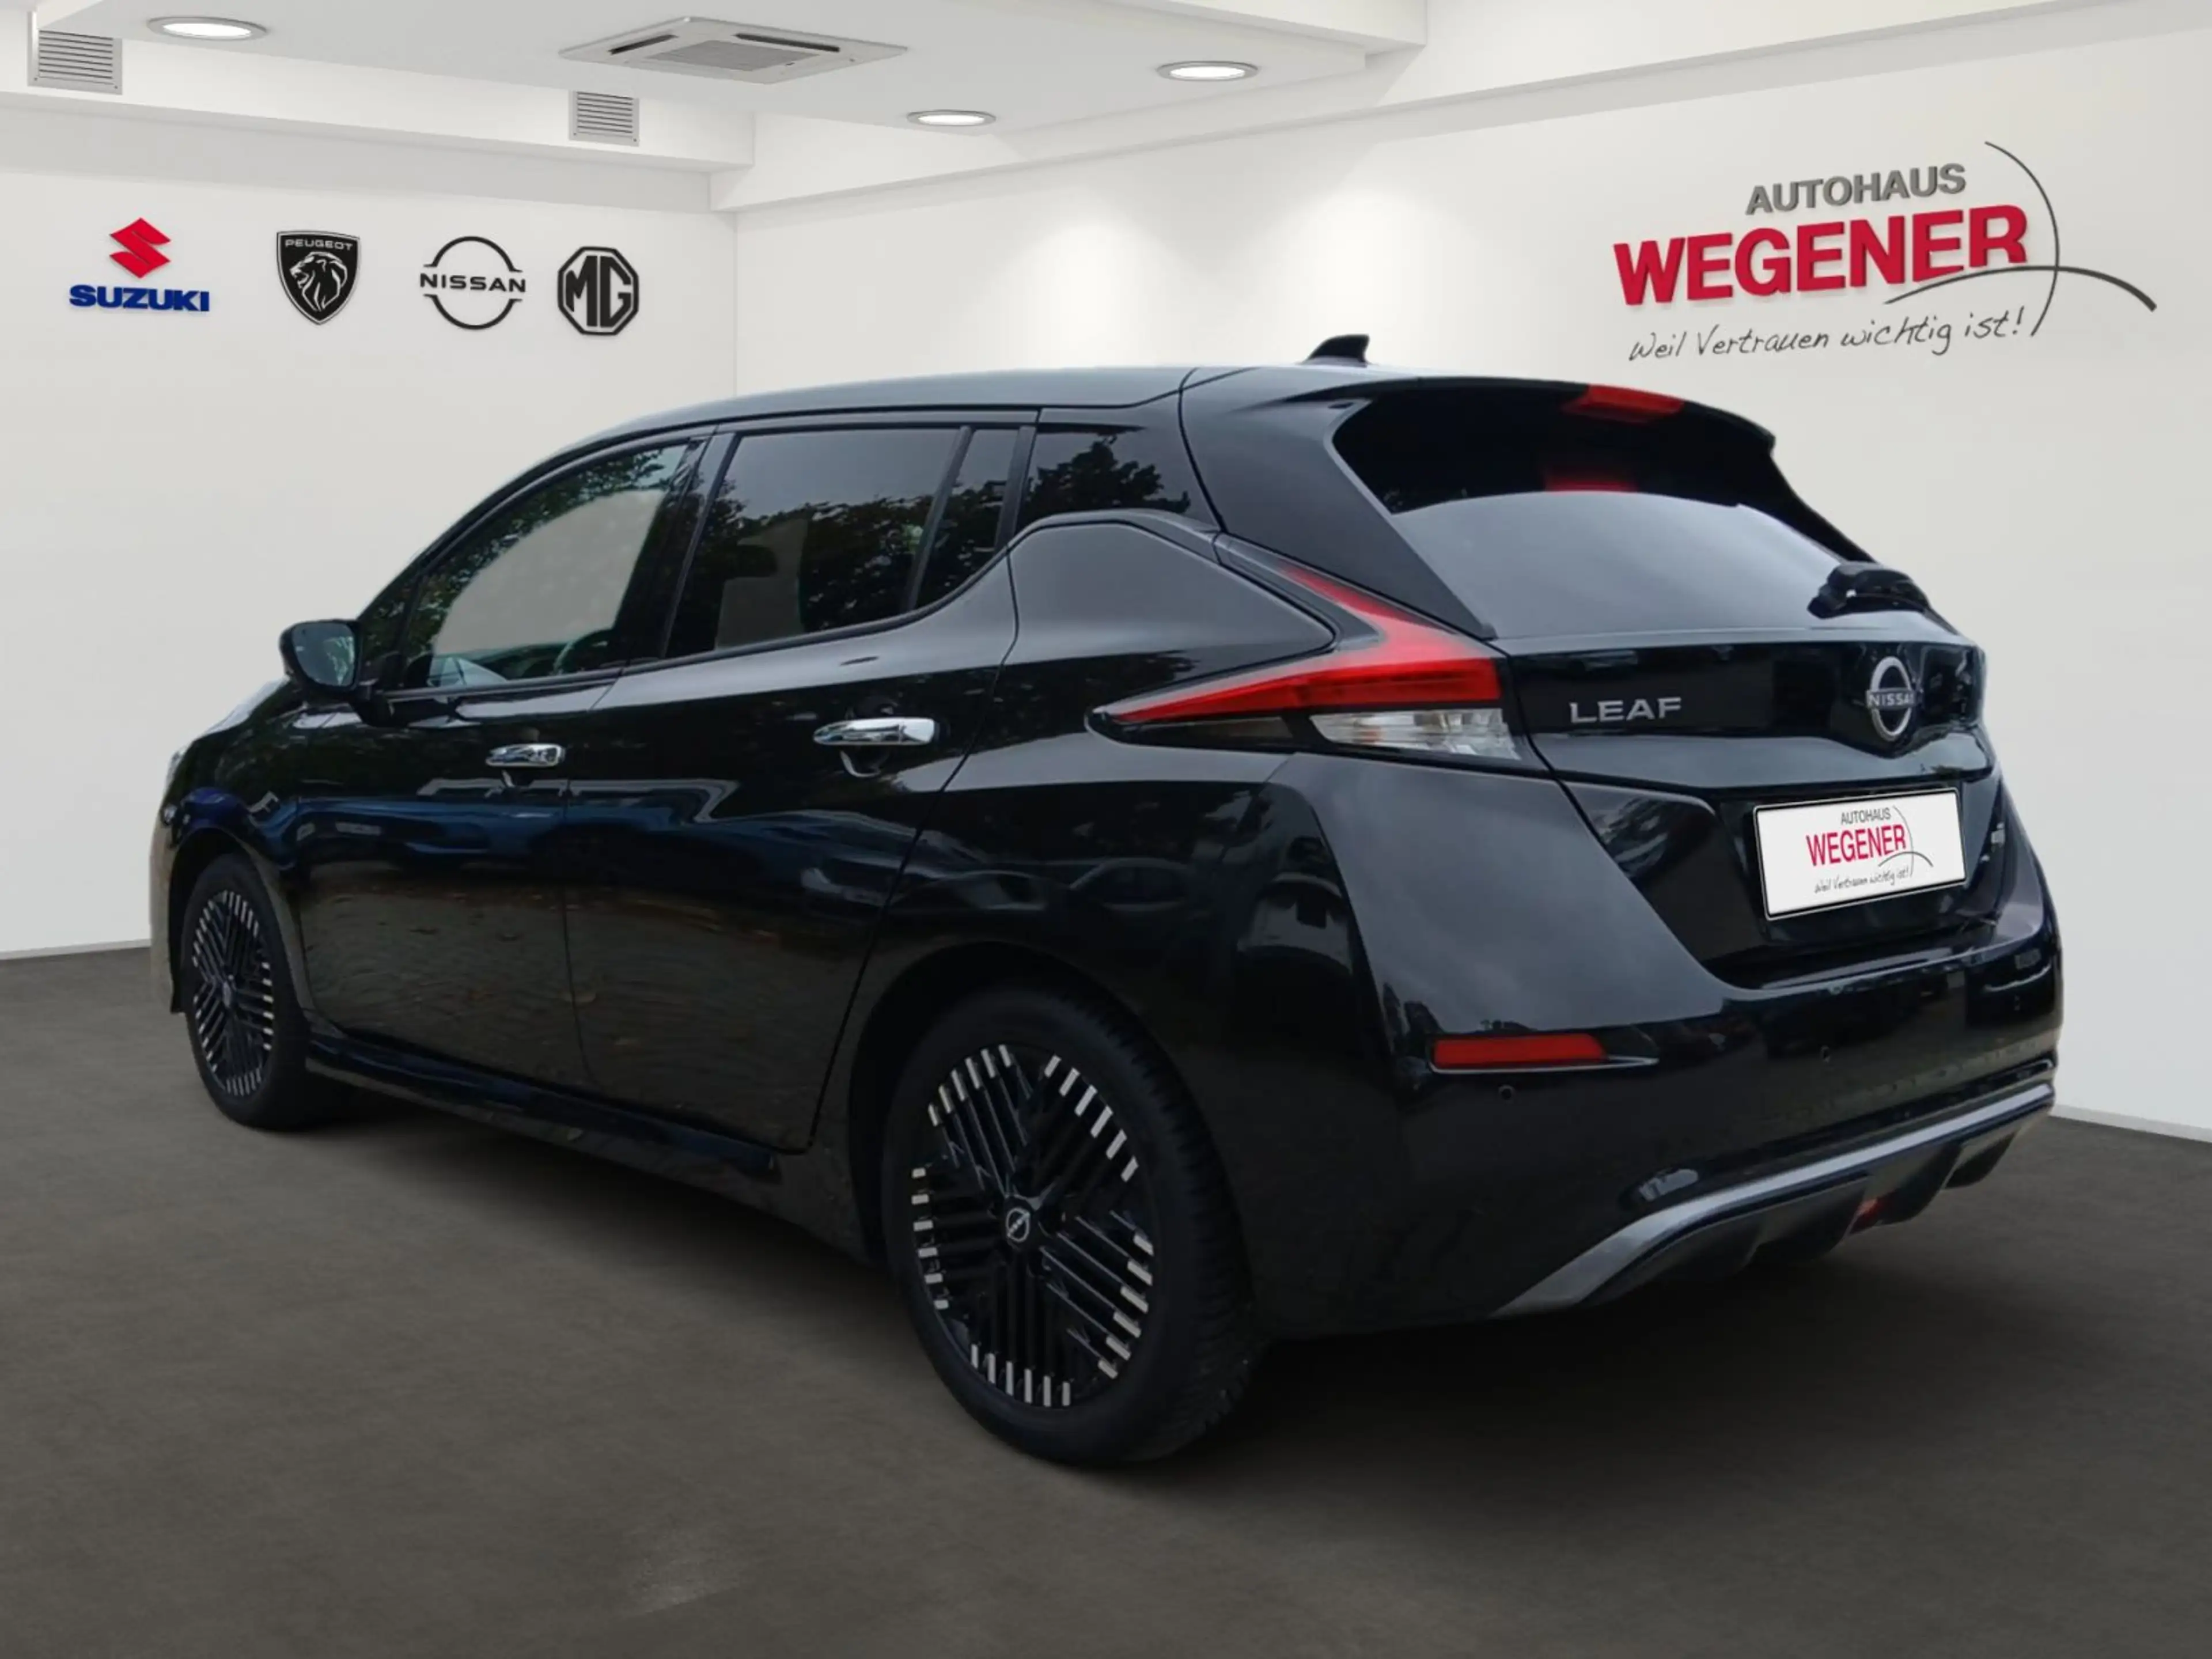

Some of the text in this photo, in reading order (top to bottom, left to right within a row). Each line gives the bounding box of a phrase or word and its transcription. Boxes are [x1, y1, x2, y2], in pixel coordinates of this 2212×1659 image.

[1746, 163, 1966, 215] AUTOHAUS
[285, 238, 353, 251] PEUGEOT
[1613, 204, 2028, 305] WEGENER
[69, 285, 210, 312] SUZUKI
[419, 273, 525, 293] NISSAN
[565, 255, 631, 327] MG
[1628, 305, 2024, 361] Weil Vertrauen wichtig ist!
[1569, 696, 1681, 724] LEAF
[1841, 807, 1891, 824] AUTOHAUS
[1806, 824, 1906, 866] WEGENER
